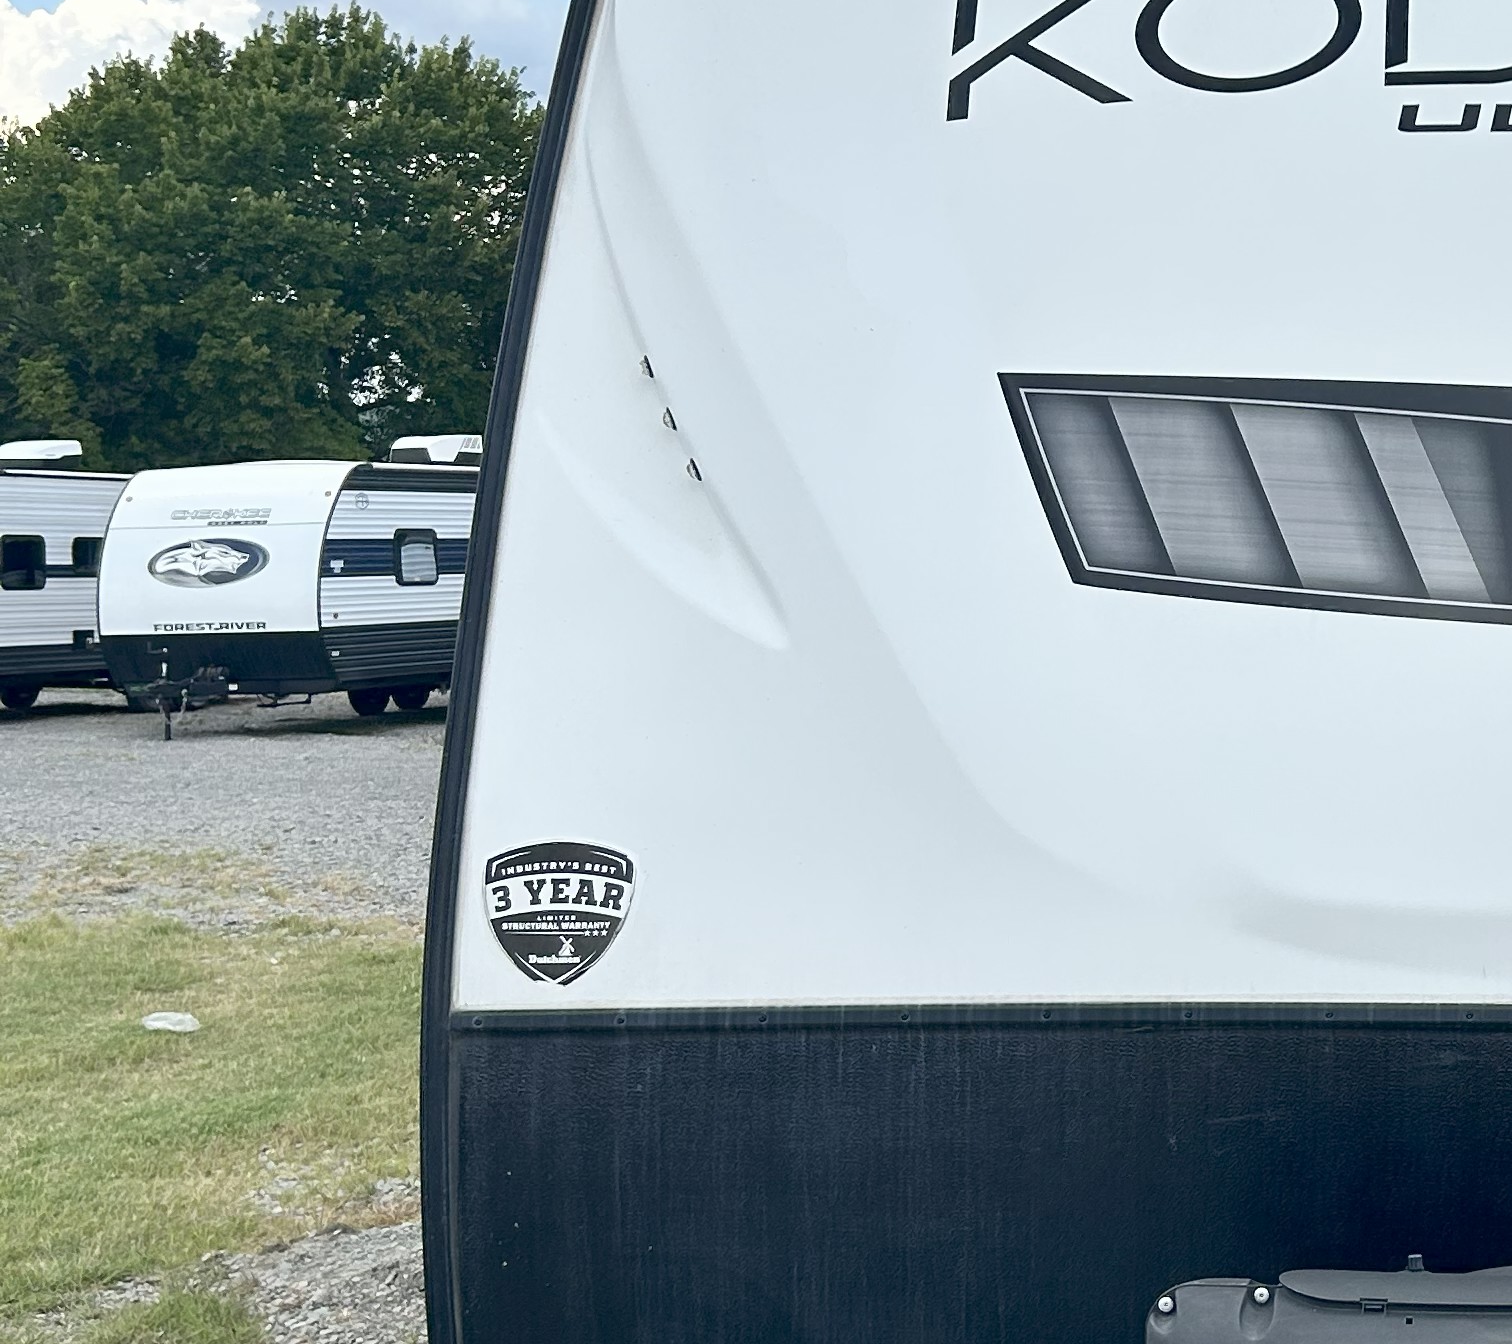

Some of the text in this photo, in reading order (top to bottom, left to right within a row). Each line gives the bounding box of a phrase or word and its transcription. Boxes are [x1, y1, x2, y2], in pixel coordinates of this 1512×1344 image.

[153, 621, 267, 632] FOREST RIVER
[501, 861, 617, 876] INDUSTRY'S BEST
[492, 878, 625, 913] 3 YEAR
[501, 921, 611, 931] STRUCTURAL WARRANTY
